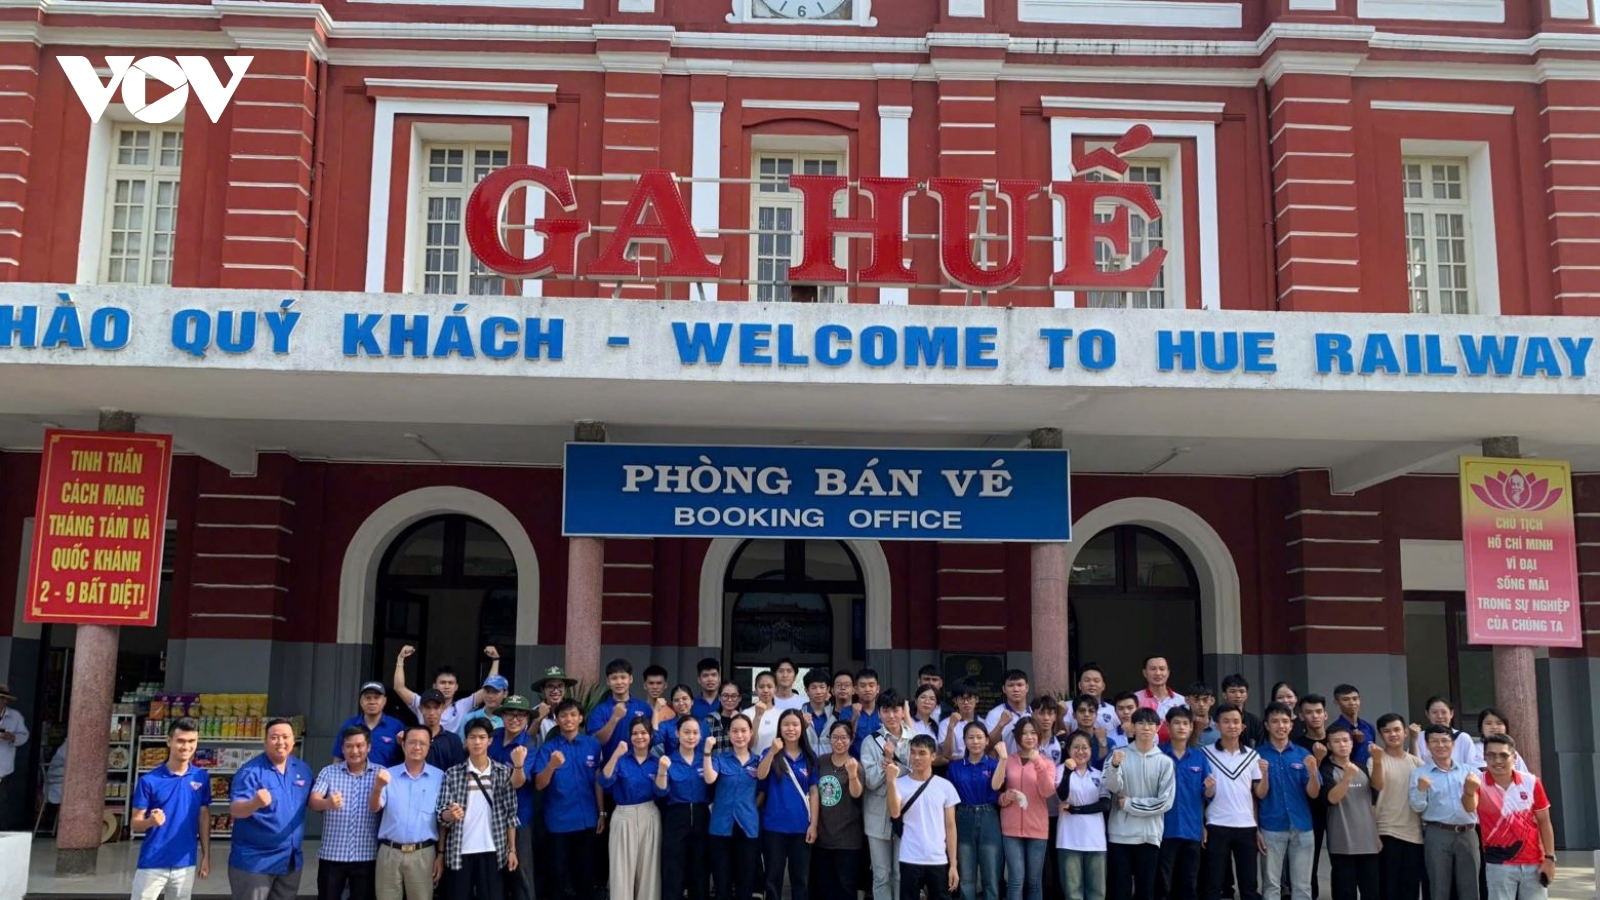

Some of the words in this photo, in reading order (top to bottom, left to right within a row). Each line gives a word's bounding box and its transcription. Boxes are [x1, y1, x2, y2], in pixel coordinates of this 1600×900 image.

[797, 5, 807, 17] 6
[465, 163, 722, 282] GA
[786, 123, 1168, 292] HUẾ
[171, 299, 302, 358] QUÝ
[342, 303, 565, 361] KHÁCH
[608, 336, 630, 347] -
[671, 321, 998, 370] WELCOME
[1039, 327, 1117, 371] TO
[1156, 329, 1278, 374] HUE
[1314, 332, 1594, 378] RAILWAY
[71, 450, 102, 473] TINH
[107, 447, 143, 474] THẦN
[621, 455, 793, 496] PHÒNG
[814, 457, 923, 498] BÁN
[941, 459, 1014, 499] VÉ
[61, 479, 98, 505] CÁCH
[103, 484, 145, 510] MẠNG
[49, 511, 94, 537] THÁNG
[99, 513, 128, 538] TÁM
[133, 514, 150, 539] VÀ
[674, 507, 825, 528] BOOKING
[848, 509, 963, 530] OFFICE
[1521, 518, 1544, 532] TỊCH
[1505, 535, 1522, 550] CHÍ
[1526, 538, 1554, 551] MINH
[51, 543, 89, 571] QUỐC
[93, 546, 141, 572] KHÁNH
[1519, 558, 1537, 573] ĐẠI
[40, 581, 50, 602] 2
[65, 582, 74, 603] 9
[78, 576, 105, 604] BẤT
[109, 578, 145, 610] DIỆT!
[1496, 575, 1525, 590] SỐNG
[1477, 597, 1511, 610] TRONG
[1533, 597, 1570, 615] NGHIỆP
[1487, 614, 1509, 630] CỦA
[1512, 617, 1547, 631] CHÚNG
[1550, 620, 1563, 633] TA
